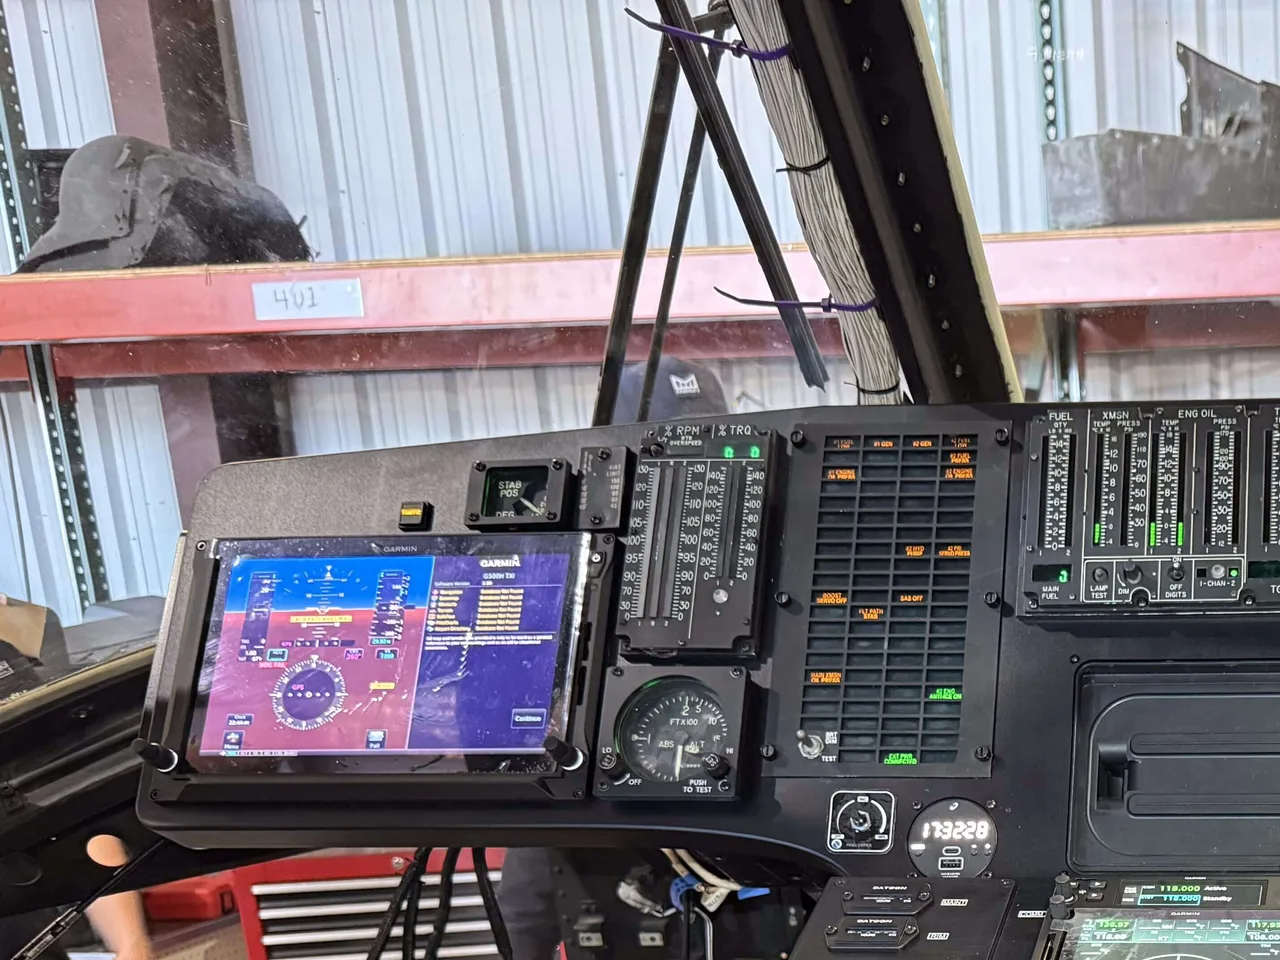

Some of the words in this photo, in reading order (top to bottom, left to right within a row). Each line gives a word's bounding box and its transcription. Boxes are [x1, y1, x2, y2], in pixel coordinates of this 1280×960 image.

[273, 287, 318, 310] 401
[1178, 410, 1198, 418] ENG
[665, 426, 672, 436] %
[677, 426, 700, 435] RPM
[719, 425, 727, 436] %
[730, 426, 751, 436] TRQ
[498, 481, 522, 489] STAB
[480, 559, 520, 567] GARMIN
[1203, 895, 1232, 903] Standby
